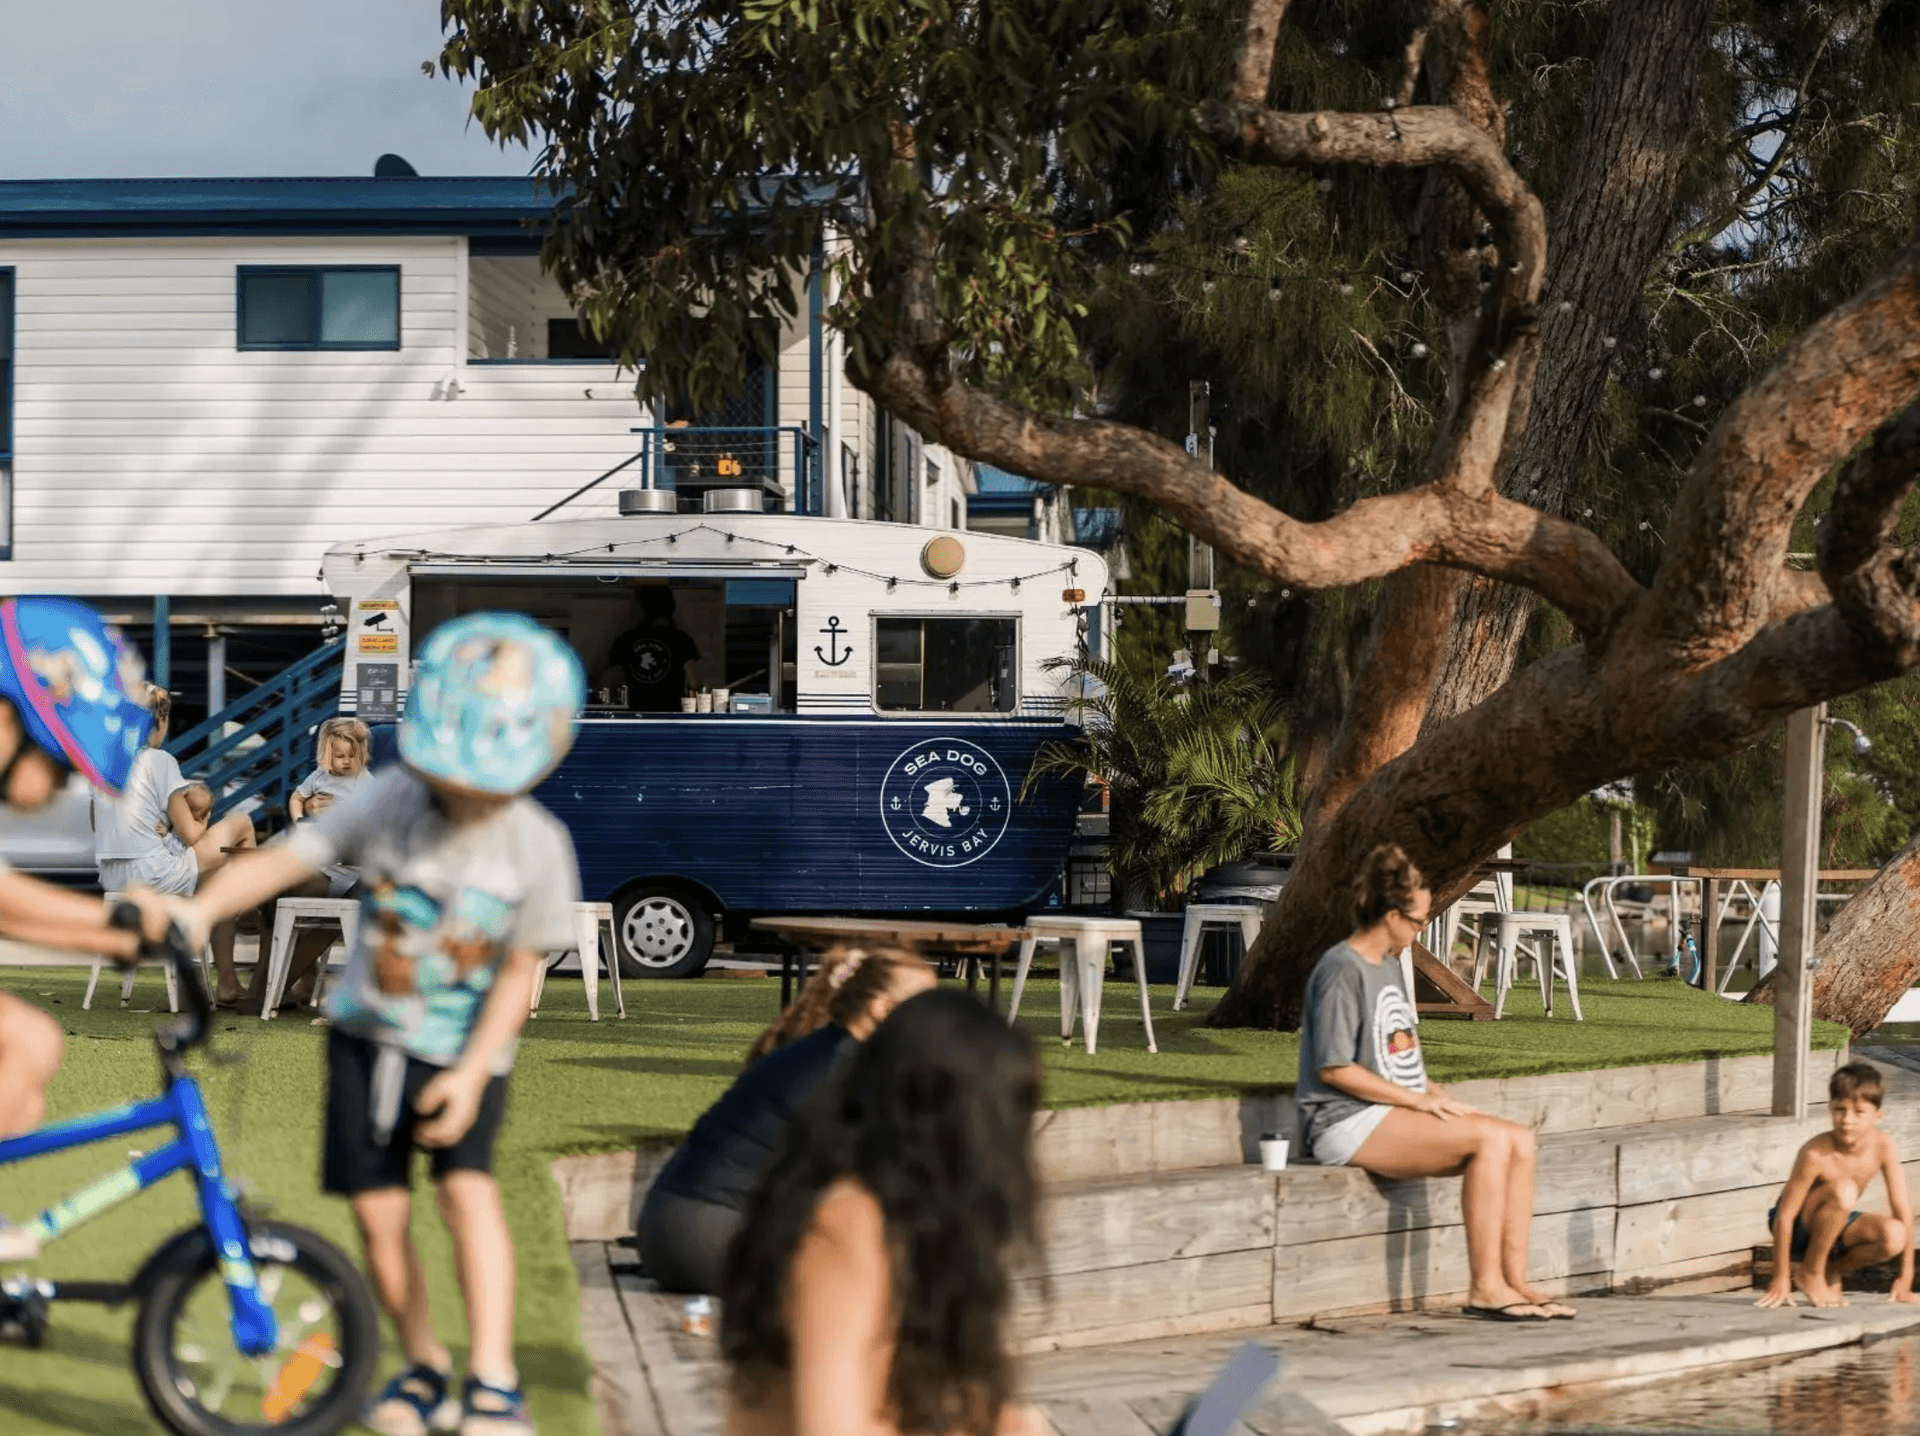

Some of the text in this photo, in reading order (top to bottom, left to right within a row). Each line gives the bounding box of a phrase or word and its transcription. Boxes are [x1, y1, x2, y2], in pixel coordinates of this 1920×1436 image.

[904, 750, 987, 776] SEA DOG
[902, 828, 988, 857] JERVIS BAY
